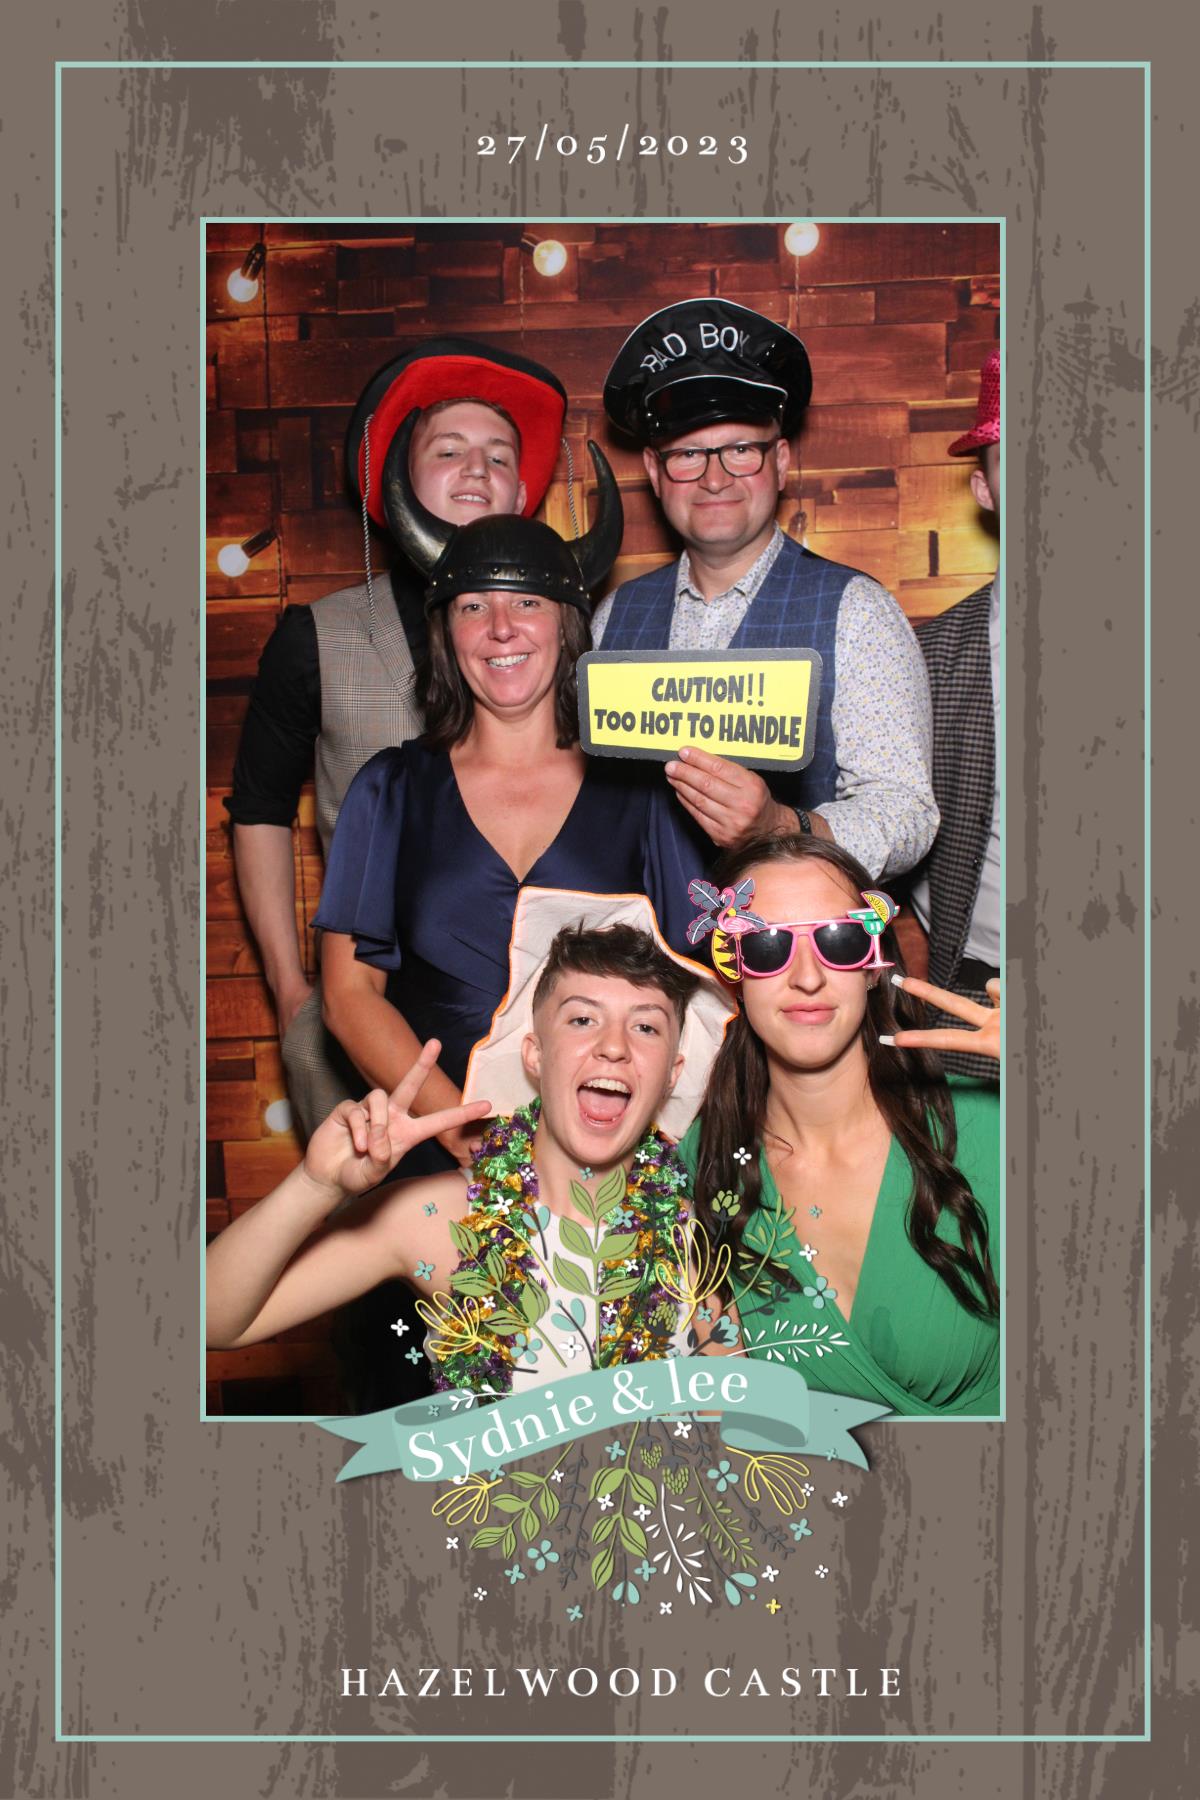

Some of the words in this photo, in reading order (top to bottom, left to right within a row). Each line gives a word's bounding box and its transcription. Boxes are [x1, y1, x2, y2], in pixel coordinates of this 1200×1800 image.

[640, 333, 687, 373] BAD
[699, 323, 750, 357] BOY
[651, 672, 765, 707] CAUTION!!
[594, 709, 636, 732] TOO
[640, 711, 683, 737] HOT
[687, 712, 714, 739] TO
[719, 714, 802, 747] HANDLE
